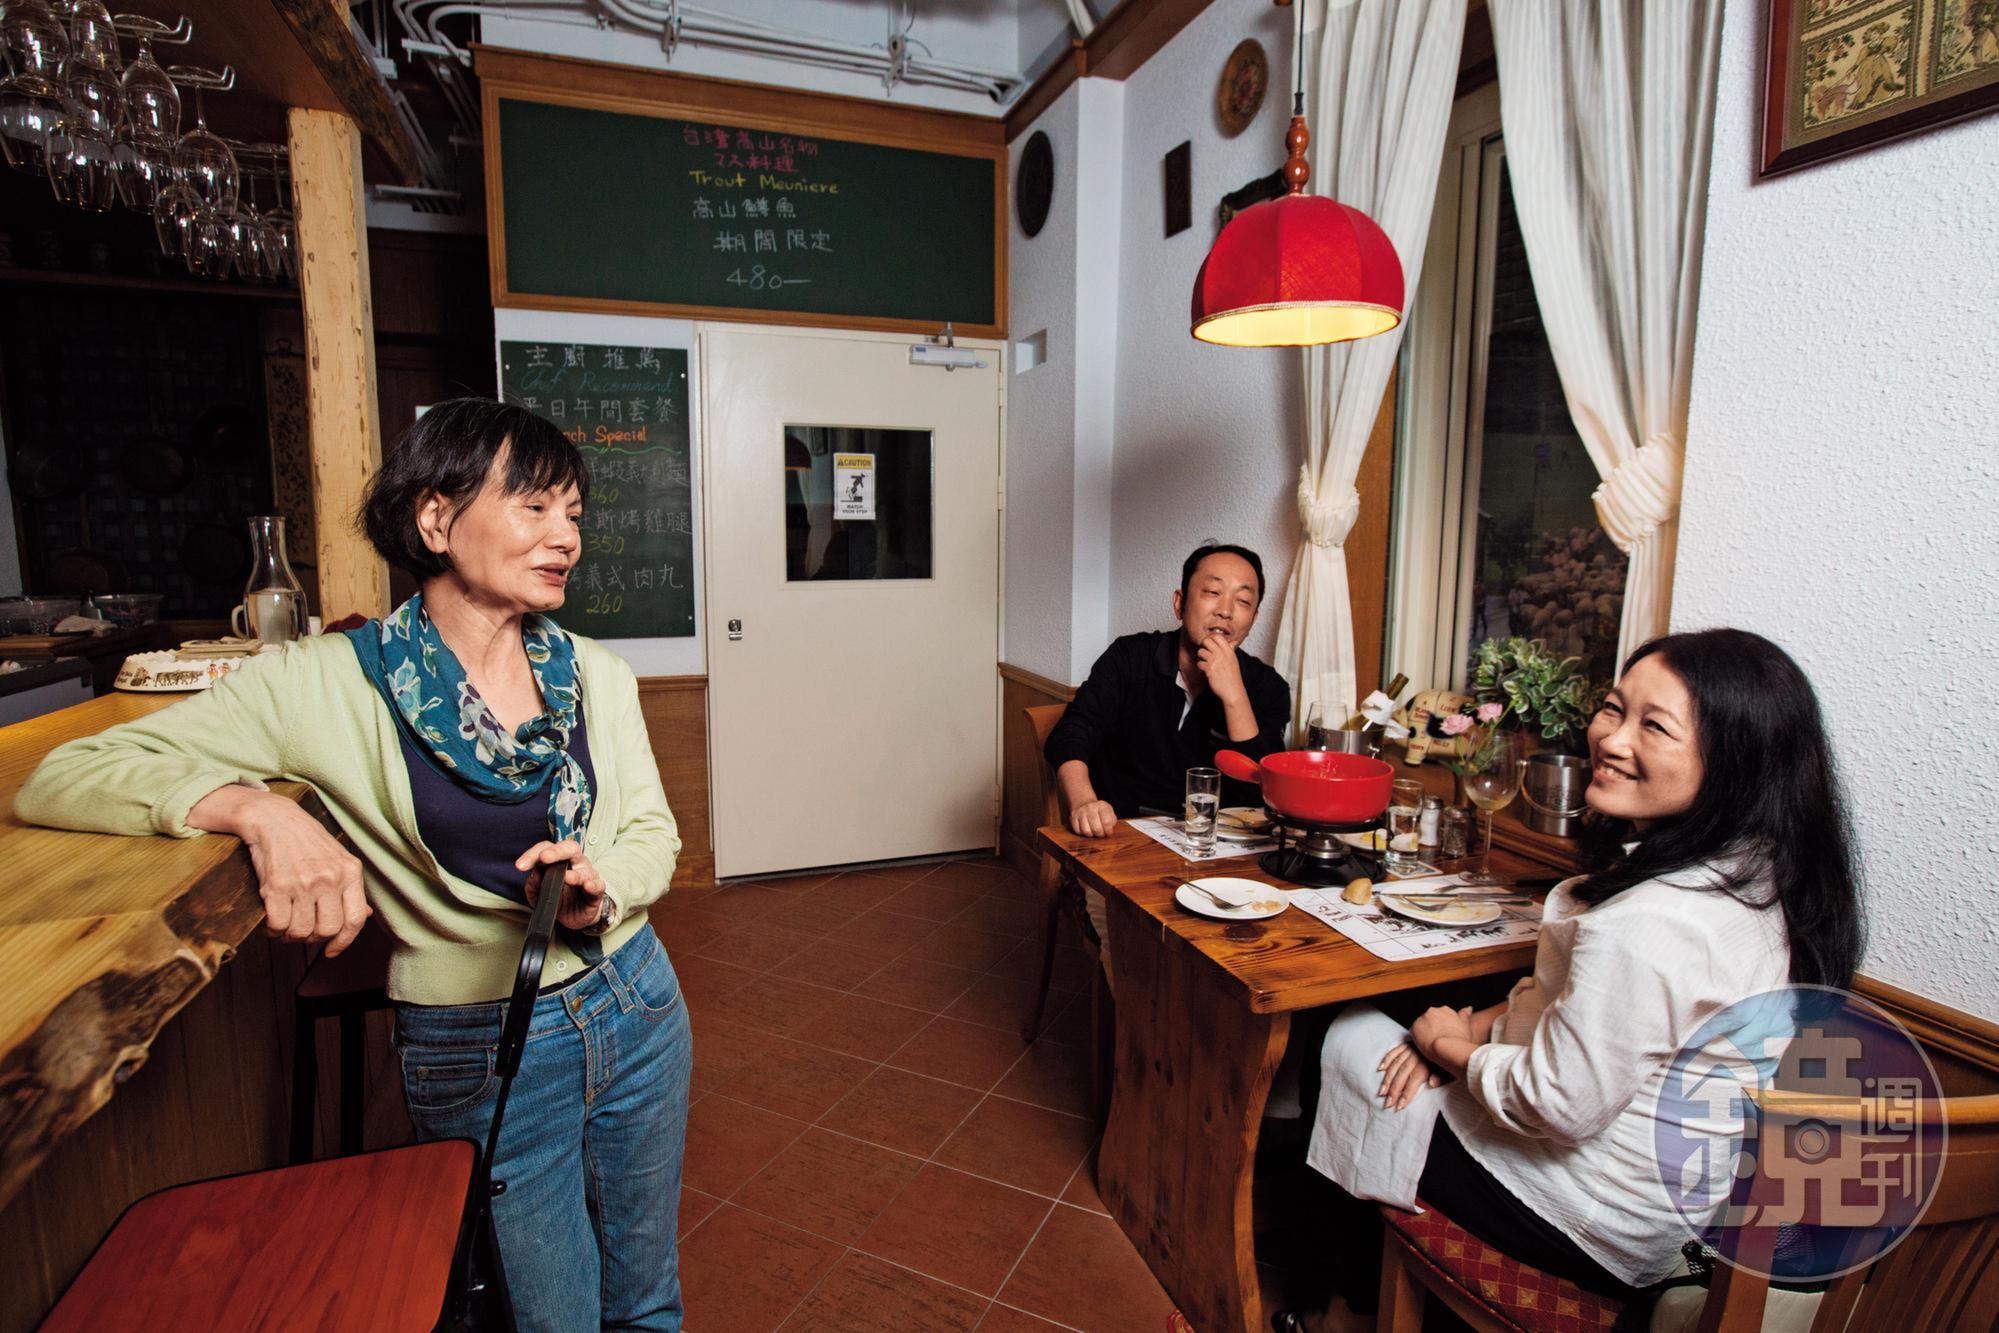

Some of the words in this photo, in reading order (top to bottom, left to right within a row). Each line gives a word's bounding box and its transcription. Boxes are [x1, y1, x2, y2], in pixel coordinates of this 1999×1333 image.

[689, 169, 747, 187] Trout
[759, 174, 840, 194] Meuniere
[692, 195, 797, 219] 高山鱒魚
[712, 229, 833, 253] 期間限定
[526, 344, 661, 374] 主廚推薦
[595, 425, 648, 448] Special
[844, 457, 871, 466] CAUTION
[587, 534, 625, 555] 350
[586, 593, 623, 614] 260
